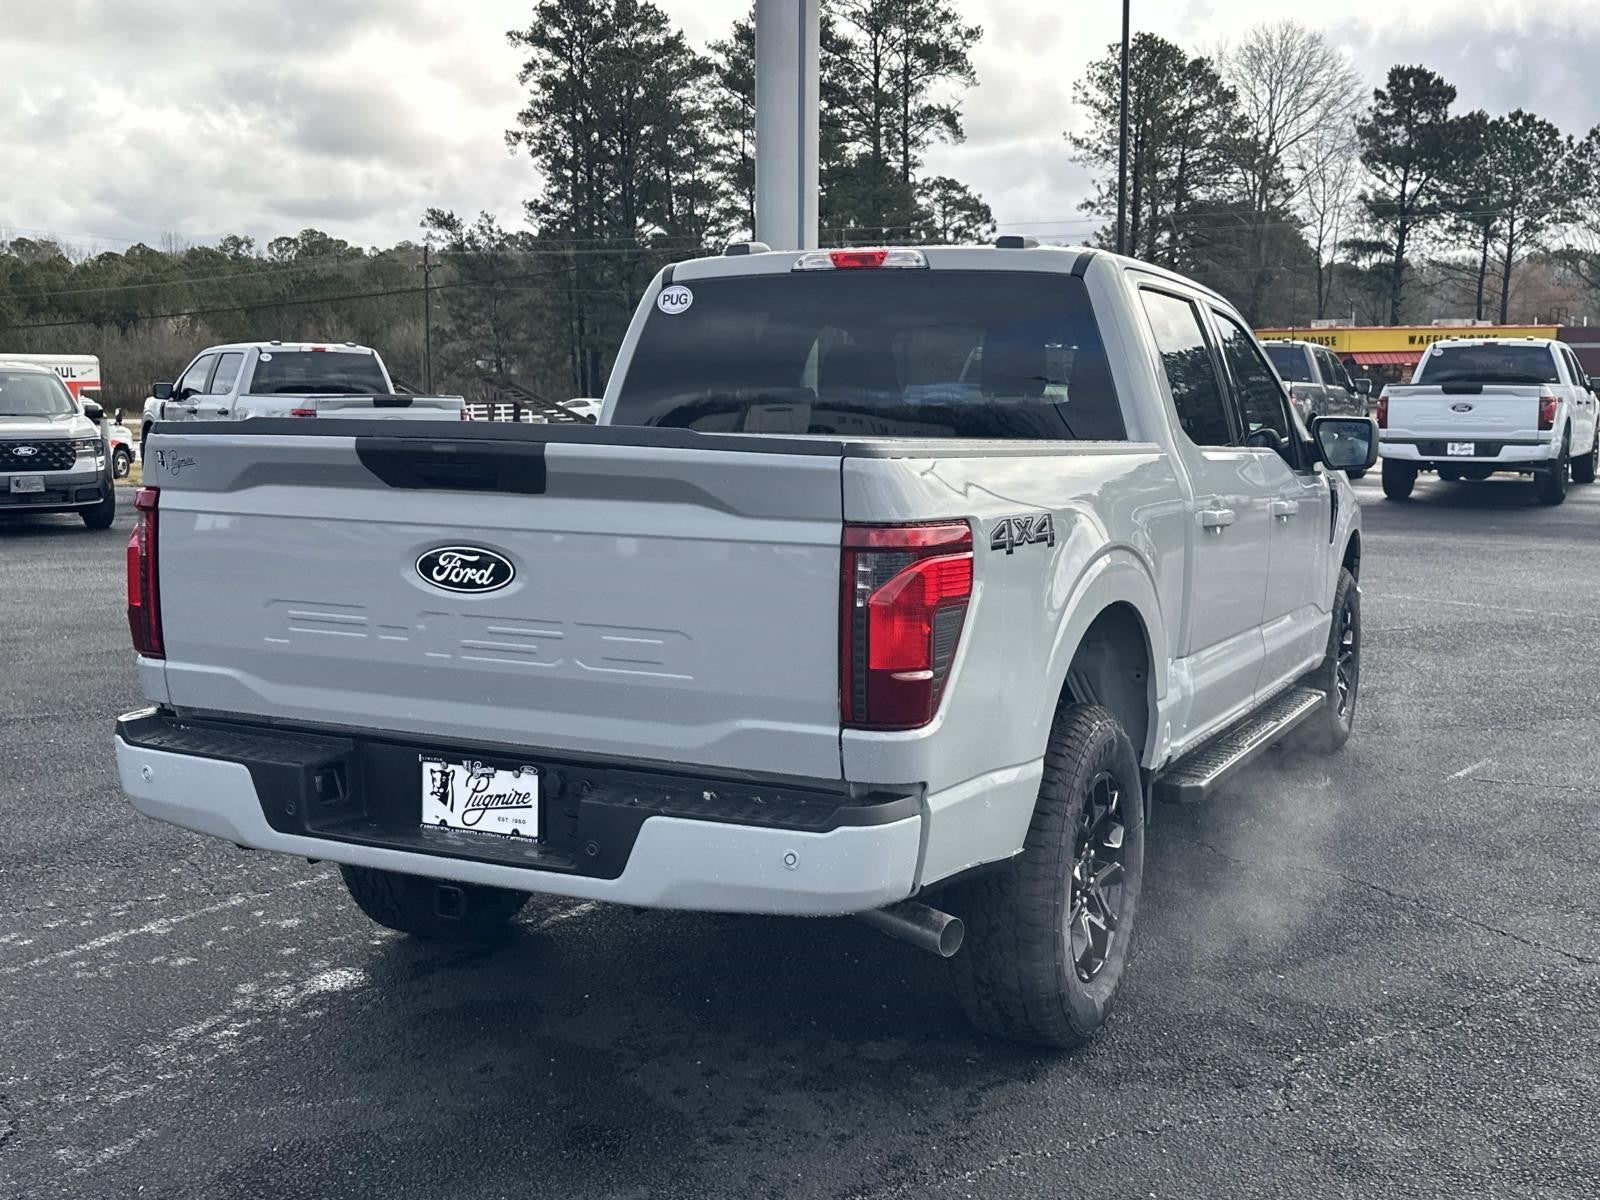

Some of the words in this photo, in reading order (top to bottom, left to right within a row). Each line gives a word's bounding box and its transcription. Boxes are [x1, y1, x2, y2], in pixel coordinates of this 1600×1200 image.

[662, 293, 689, 306] PUG
[432, 551, 496, 585] Ford
[461, 774, 533, 827] Pugmire
